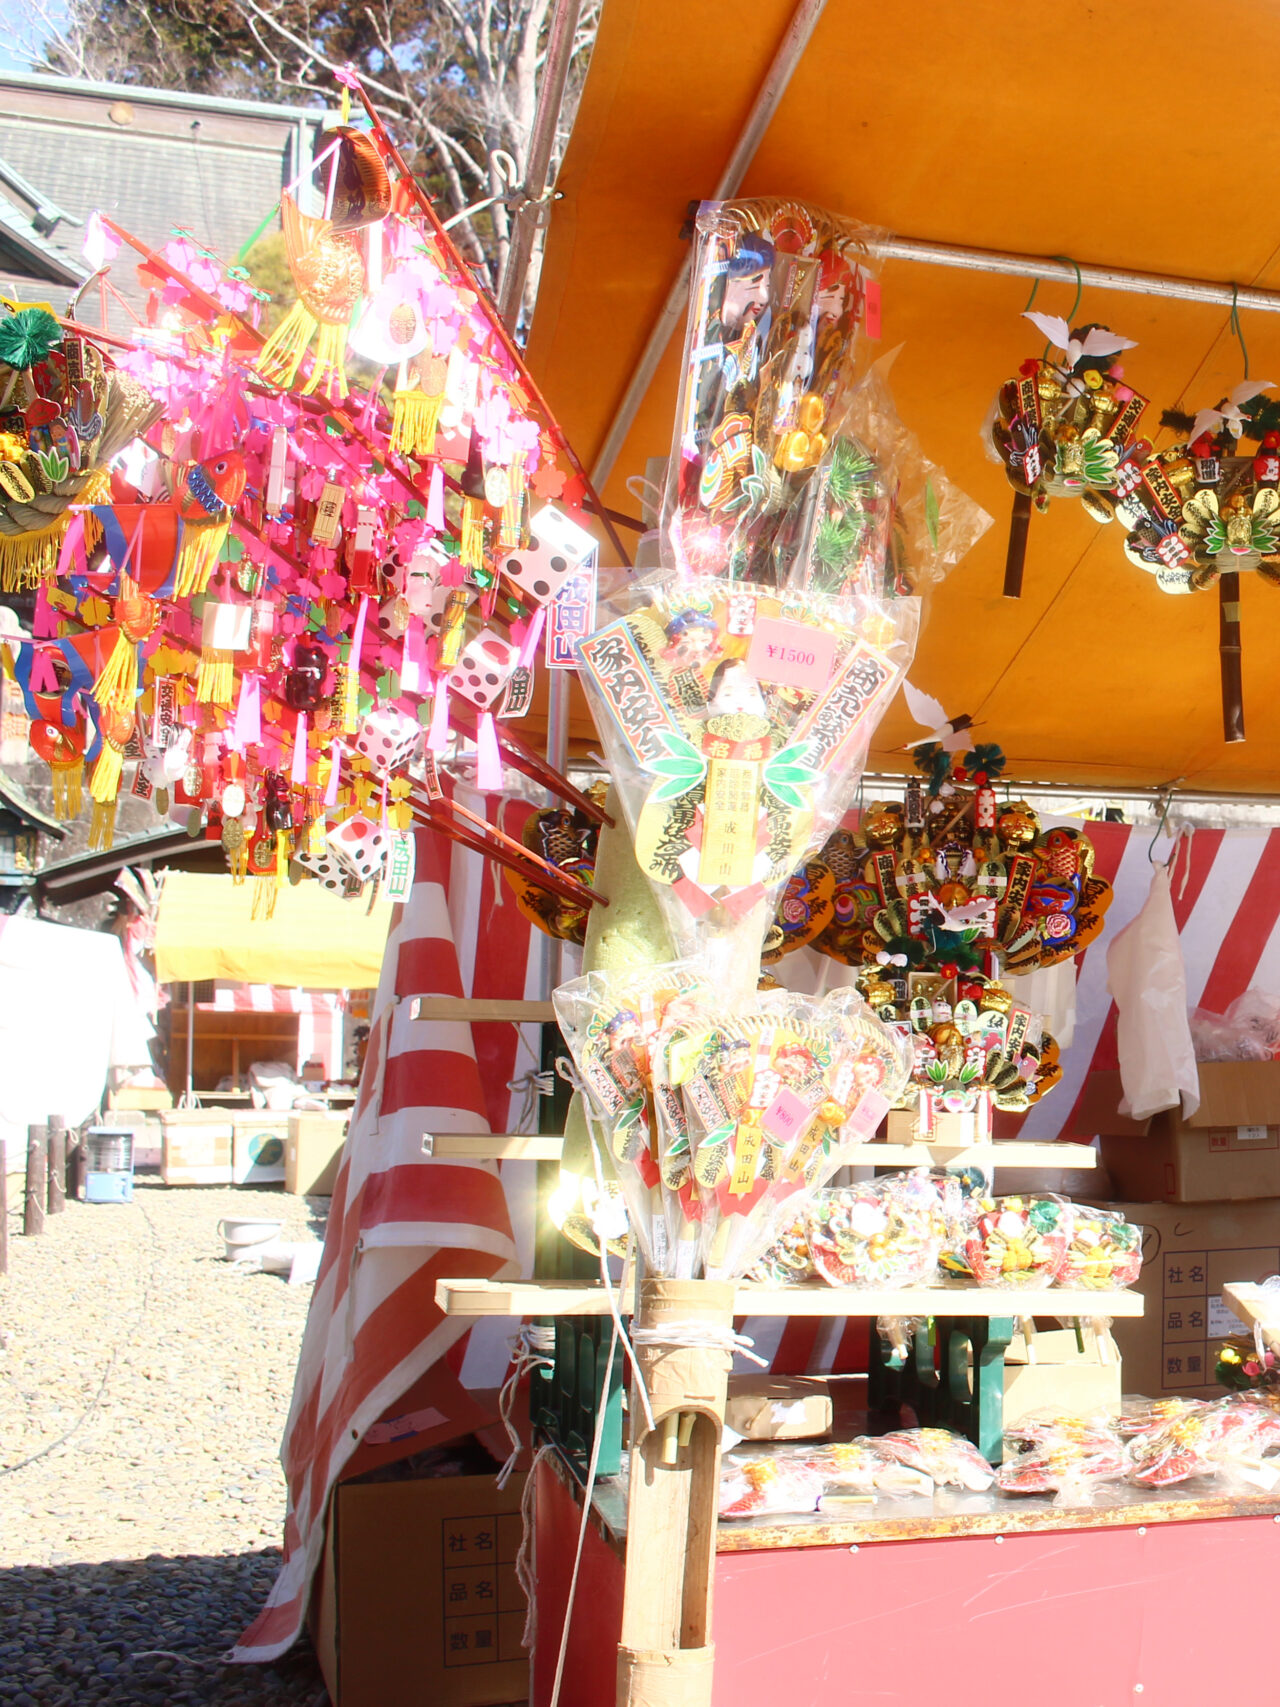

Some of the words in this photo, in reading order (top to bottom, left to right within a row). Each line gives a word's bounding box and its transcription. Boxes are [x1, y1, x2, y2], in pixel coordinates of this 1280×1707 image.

[766, 645, 816, 668] ¥1500
[719, 821, 738, 877] 成田山
[736, 1134, 756, 1182] 成田山
[788, 1124, 821, 1172] 成田山
[1168, 1265, 1204, 1284] 社名
[1168, 1311, 1204, 1330] 品名
[449, 1532, 493, 1553] 社名
[449, 1581, 494, 1602] 品名
[449, 1630, 494, 1652] 数量
